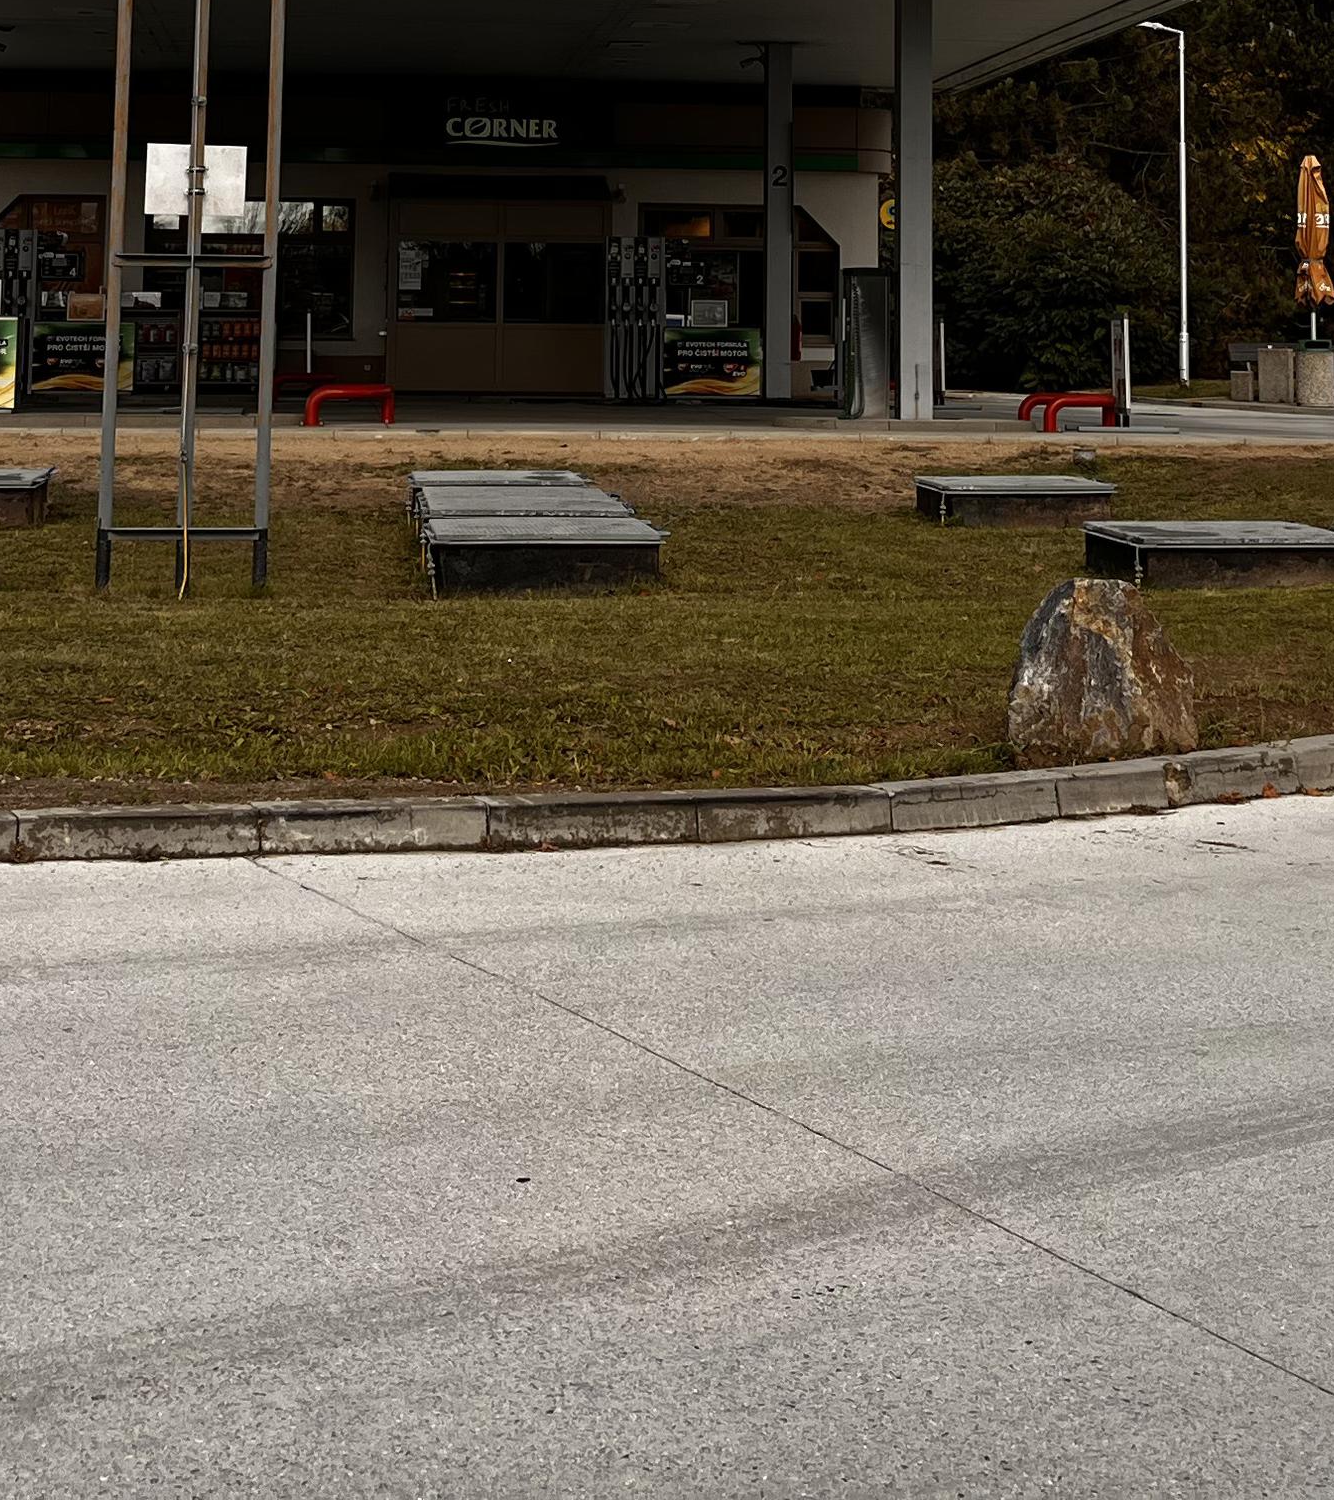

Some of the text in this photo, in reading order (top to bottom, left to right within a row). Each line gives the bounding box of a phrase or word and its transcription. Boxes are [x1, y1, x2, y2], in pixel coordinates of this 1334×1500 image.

[446, 96, 510, 114] FRESH
[445, 116, 559, 139] CORNER
[772, 165, 788, 187] 2
[695, 274, 705, 285] 2
[46, 344, 64, 352] PRO
